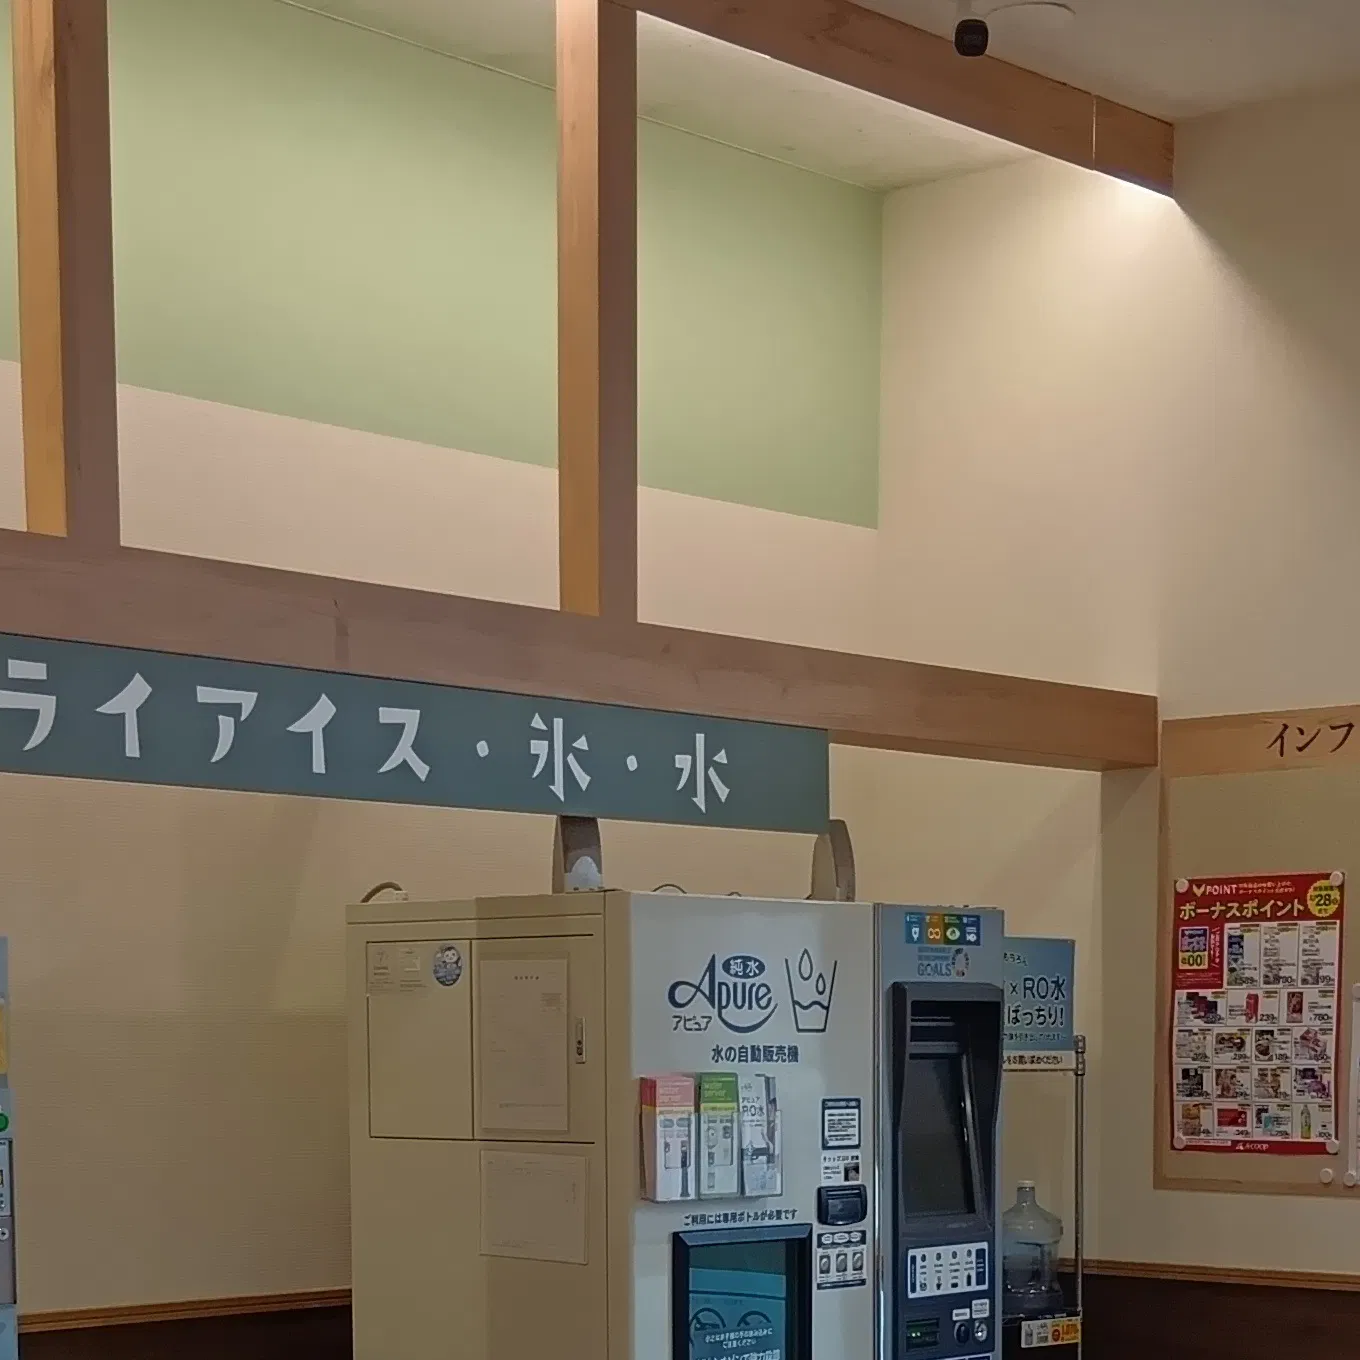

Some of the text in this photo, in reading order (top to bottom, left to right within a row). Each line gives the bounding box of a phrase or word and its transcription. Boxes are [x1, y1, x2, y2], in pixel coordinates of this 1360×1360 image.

[1179, 898, 1305, 920] ボーナスポイント
[730, 959, 760, 976] 純水
[918, 962, 952, 977] GOALS
[668, 954, 778, 1033] Apure
[672, 1015, 712, 1031] アピュア
[711, 1045, 799, 1063] 水の自動販売機
[684, 1209, 797, 1226] ご利用には専用ボトルが必要です
